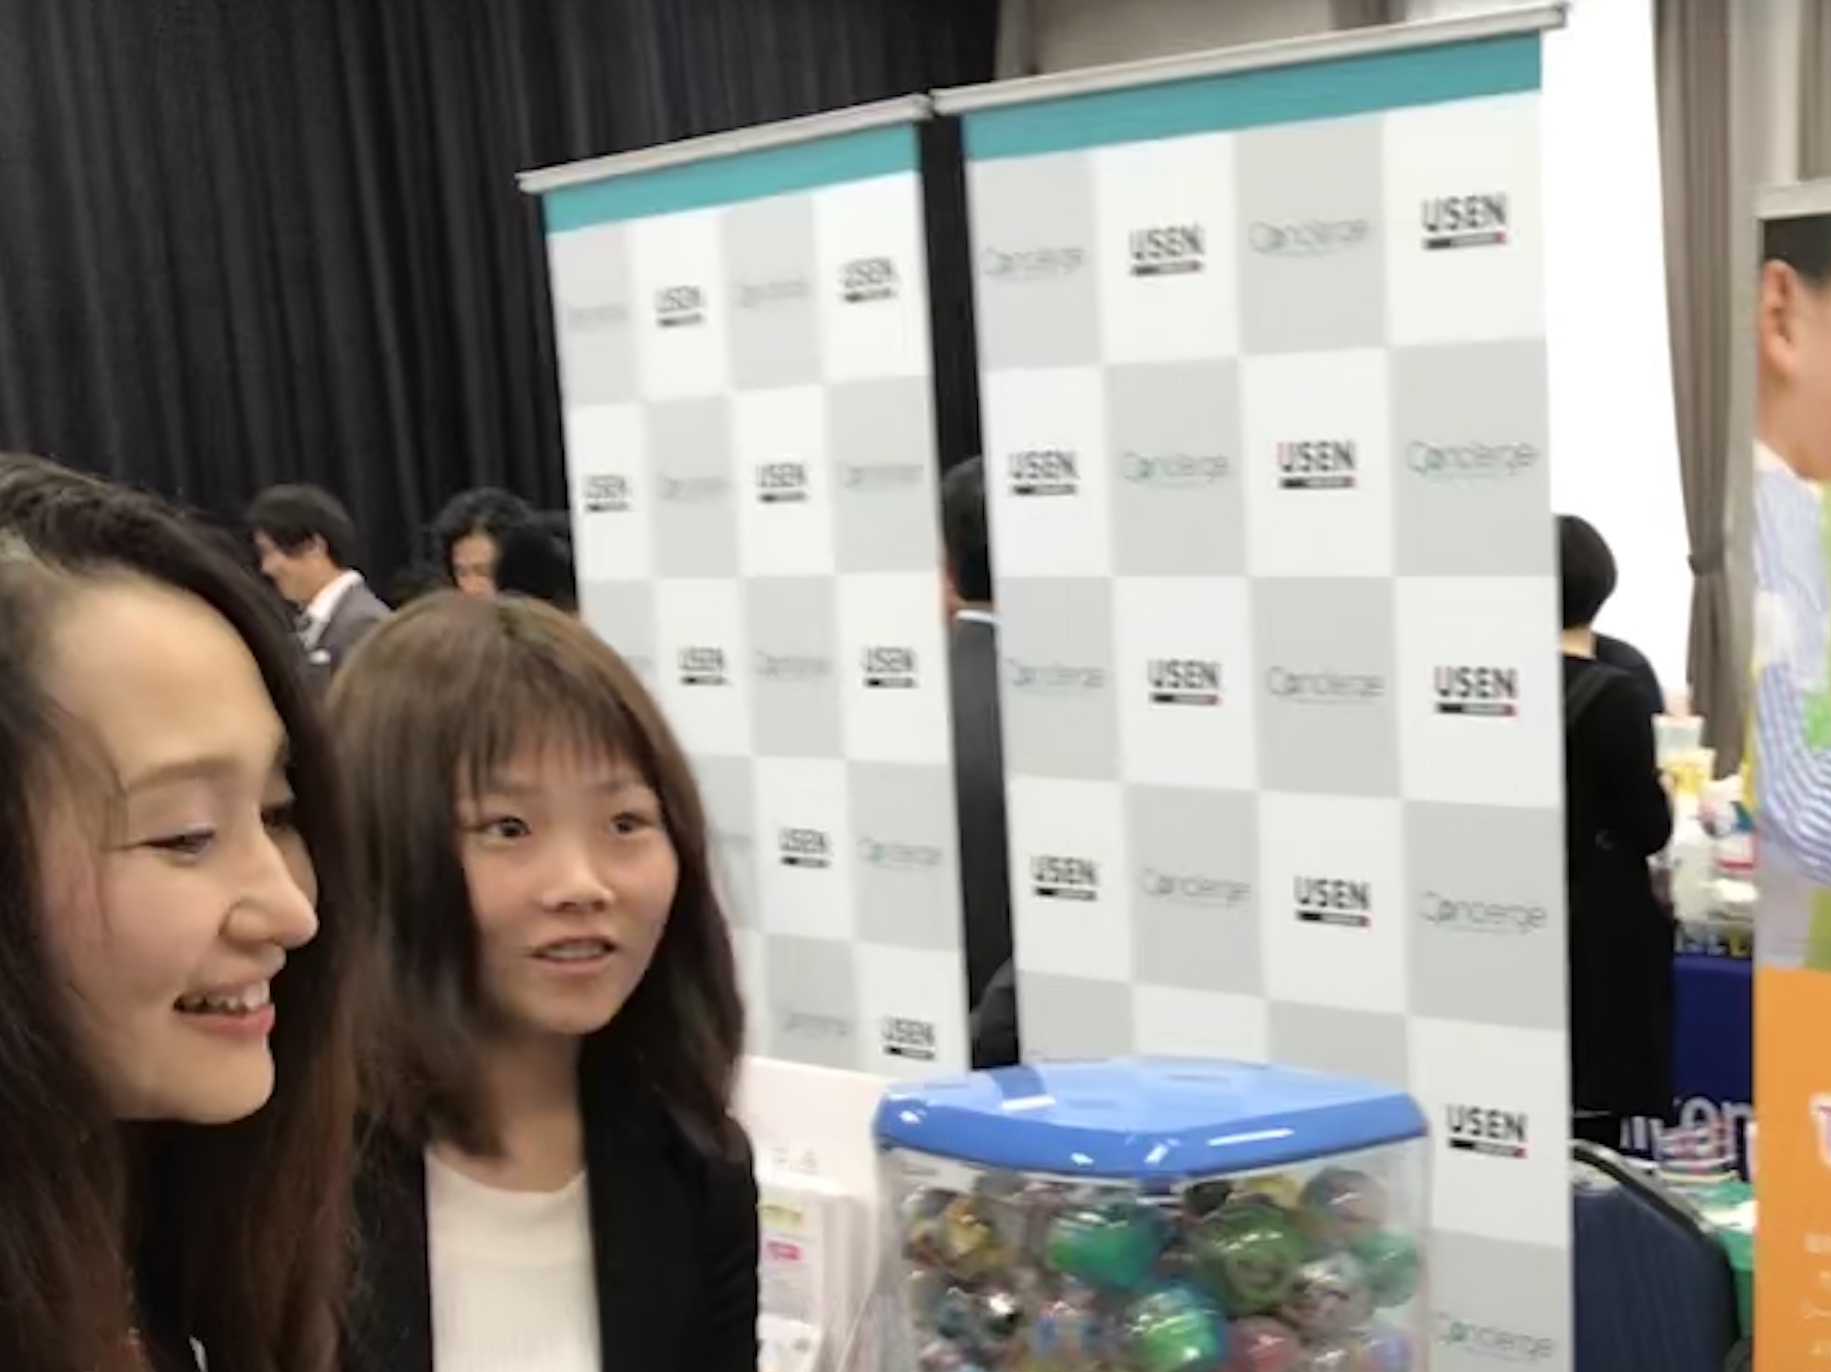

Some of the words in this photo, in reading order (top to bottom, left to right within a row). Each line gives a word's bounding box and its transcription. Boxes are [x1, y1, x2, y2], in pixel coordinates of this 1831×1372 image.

[1421, 193, 1508, 233] USEN
[1128, 222, 1204, 260] USEN
[1008, 448, 1079, 481] USEN
[1275, 438, 1357, 473] USEN
[1149, 659, 1219, 689] USEN
[1433, 665, 1518, 699] USEN
[1030, 854, 1099, 885] USEN
[1294, 876, 1371, 912] USEN
[1447, 1104, 1526, 1143] USEN
